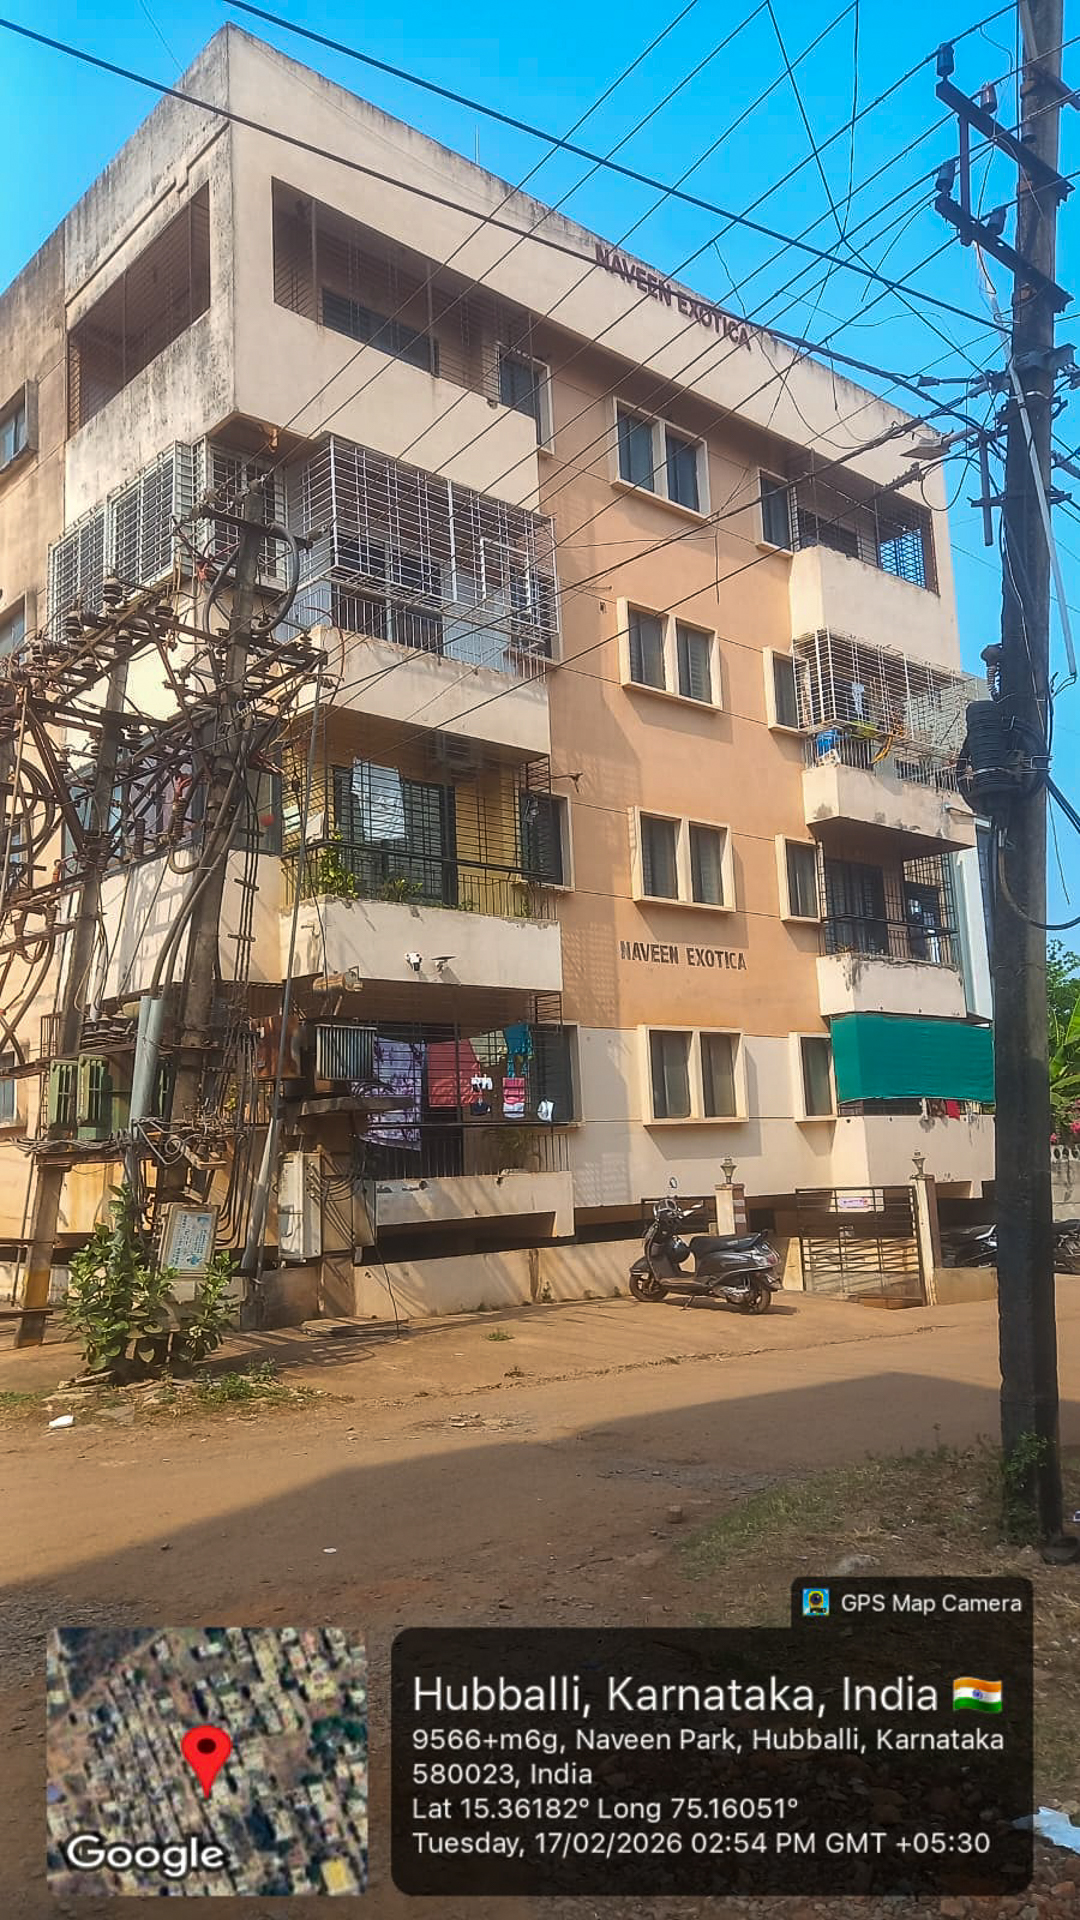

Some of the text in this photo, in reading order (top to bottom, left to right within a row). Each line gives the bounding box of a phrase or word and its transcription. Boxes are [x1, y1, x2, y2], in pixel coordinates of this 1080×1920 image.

[594, 243, 752, 351] NAVEEN EXOTICA
[620, 940, 747, 970] NAVEEN EXOTICA
